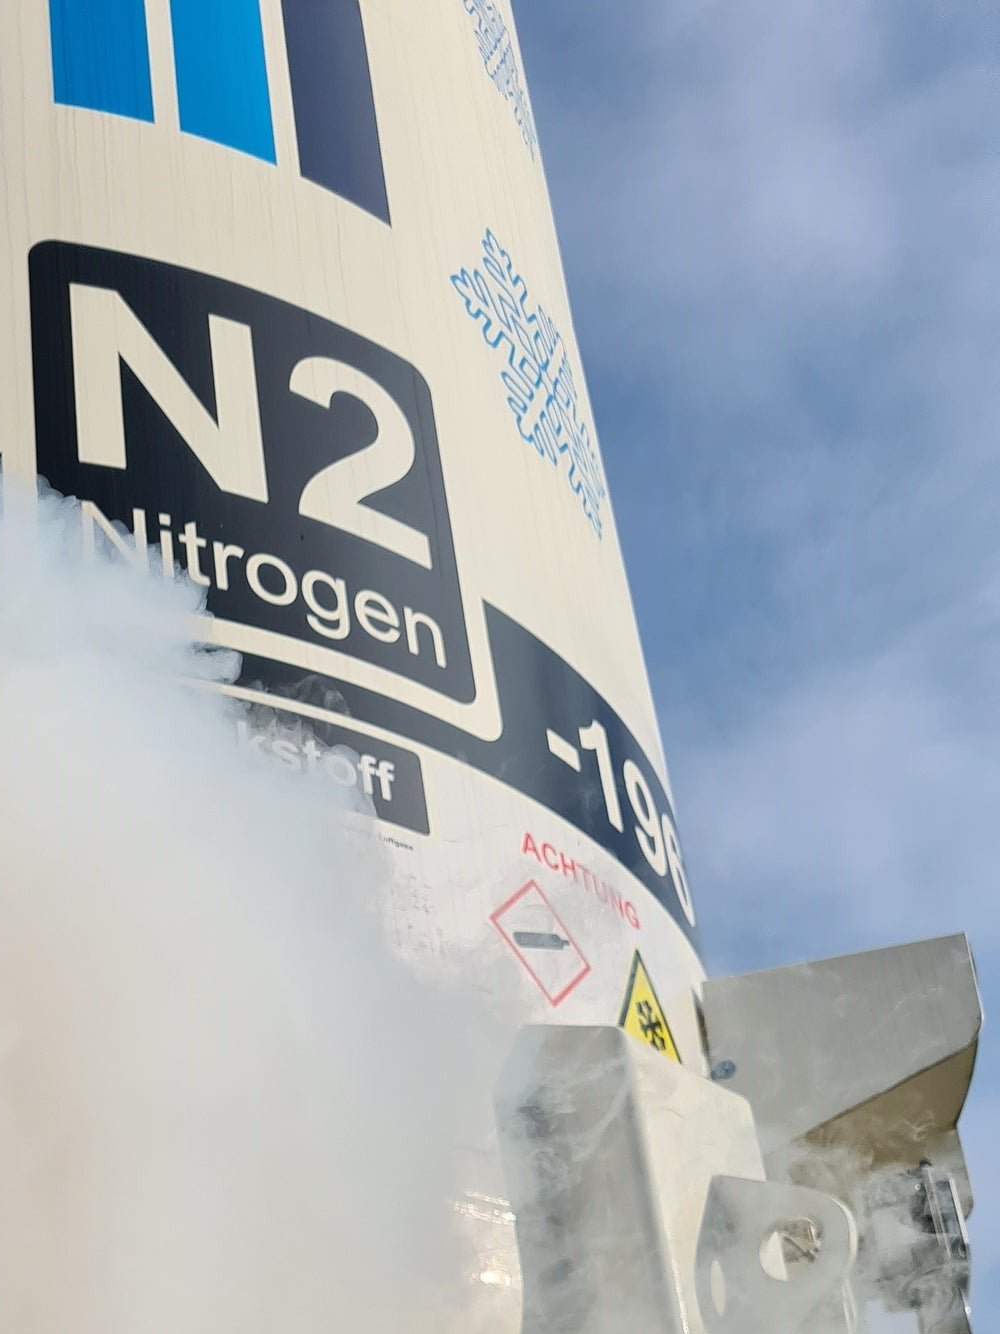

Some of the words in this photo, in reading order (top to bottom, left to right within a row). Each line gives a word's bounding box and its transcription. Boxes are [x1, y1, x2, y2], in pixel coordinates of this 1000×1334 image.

[68, 281, 433, 571] N2
[82, 500, 448, 669] Nitrogen
[235, 719, 397, 802] kstoff
[521, 831, 642, 931] ACHTUNG
